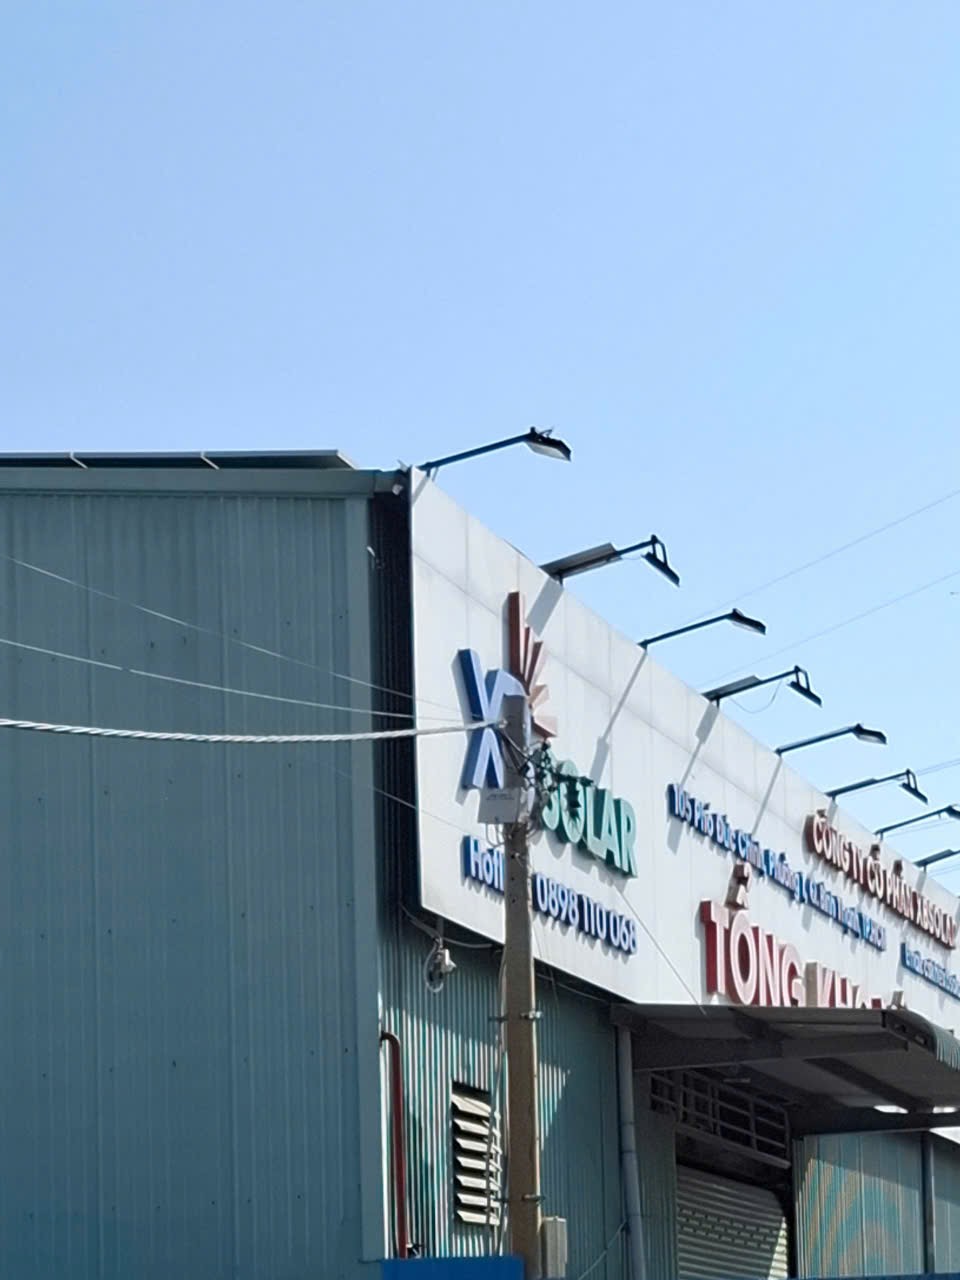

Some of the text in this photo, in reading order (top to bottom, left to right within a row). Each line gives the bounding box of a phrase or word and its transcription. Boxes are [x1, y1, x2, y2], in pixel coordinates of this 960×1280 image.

[669, 783, 692, 822] 105
[693, 800, 714, 837] Phó
[809, 811, 849, 872] CÔNG
[849, 842, 864, 885] TY
[865, 845, 884, 900] CỔ
[534, 873, 579, 929] 0898
[580, 894, 607, 940] 110
[609, 909, 638, 953] 068
[703, 862, 805, 1006] TỔNG
